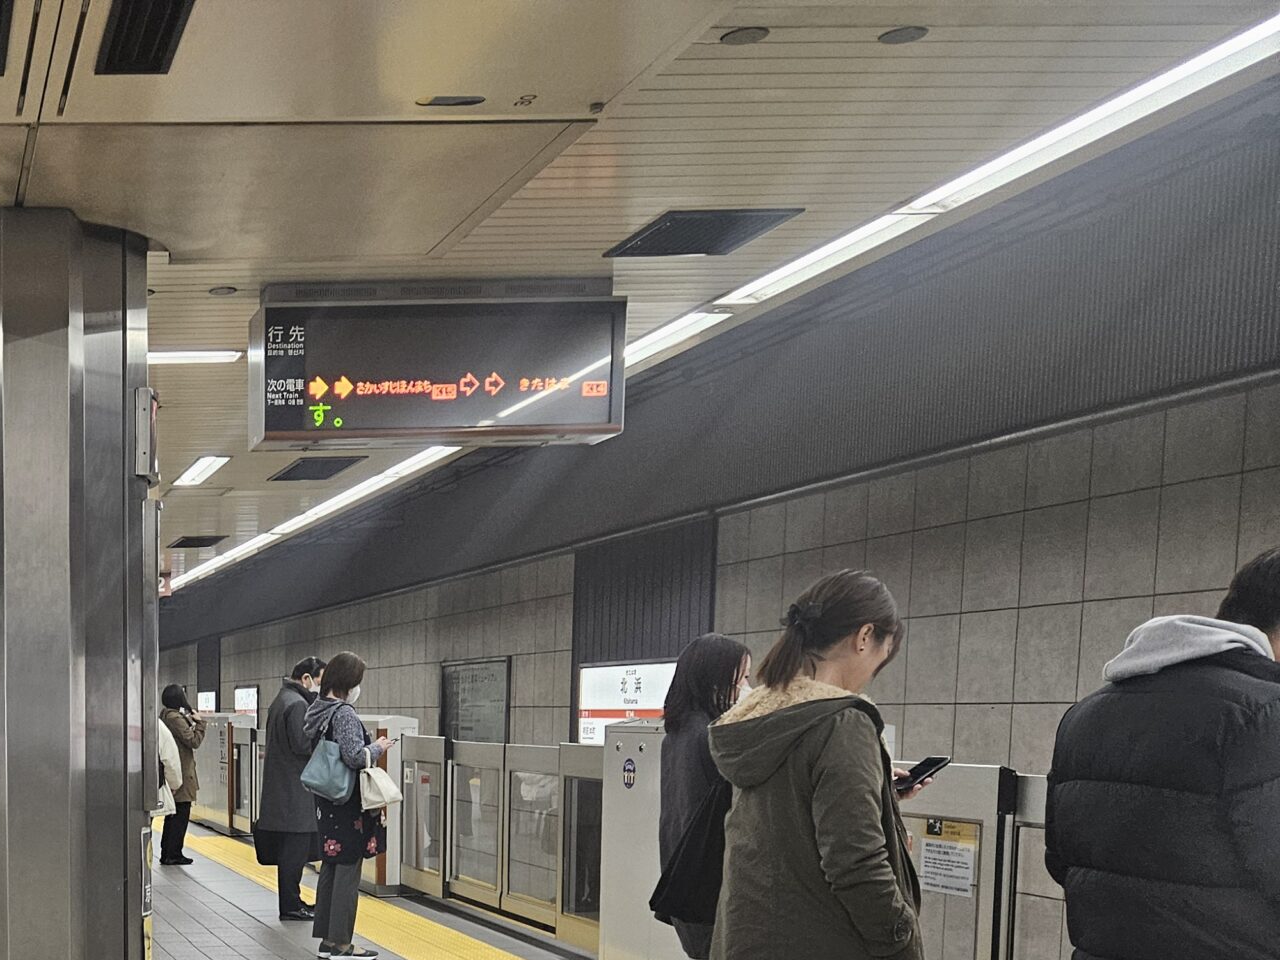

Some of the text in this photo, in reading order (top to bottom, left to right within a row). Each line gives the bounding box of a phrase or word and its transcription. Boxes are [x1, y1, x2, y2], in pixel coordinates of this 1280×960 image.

[267, 326, 305, 342] 行先
[267, 379, 305, 391] 次の電車
[356, 380, 432, 395] さかいすじほんまち
[519, 377, 571, 391] きたはま
[308, 403, 343, 427] す。
[158, 576, 166, 592] 2
